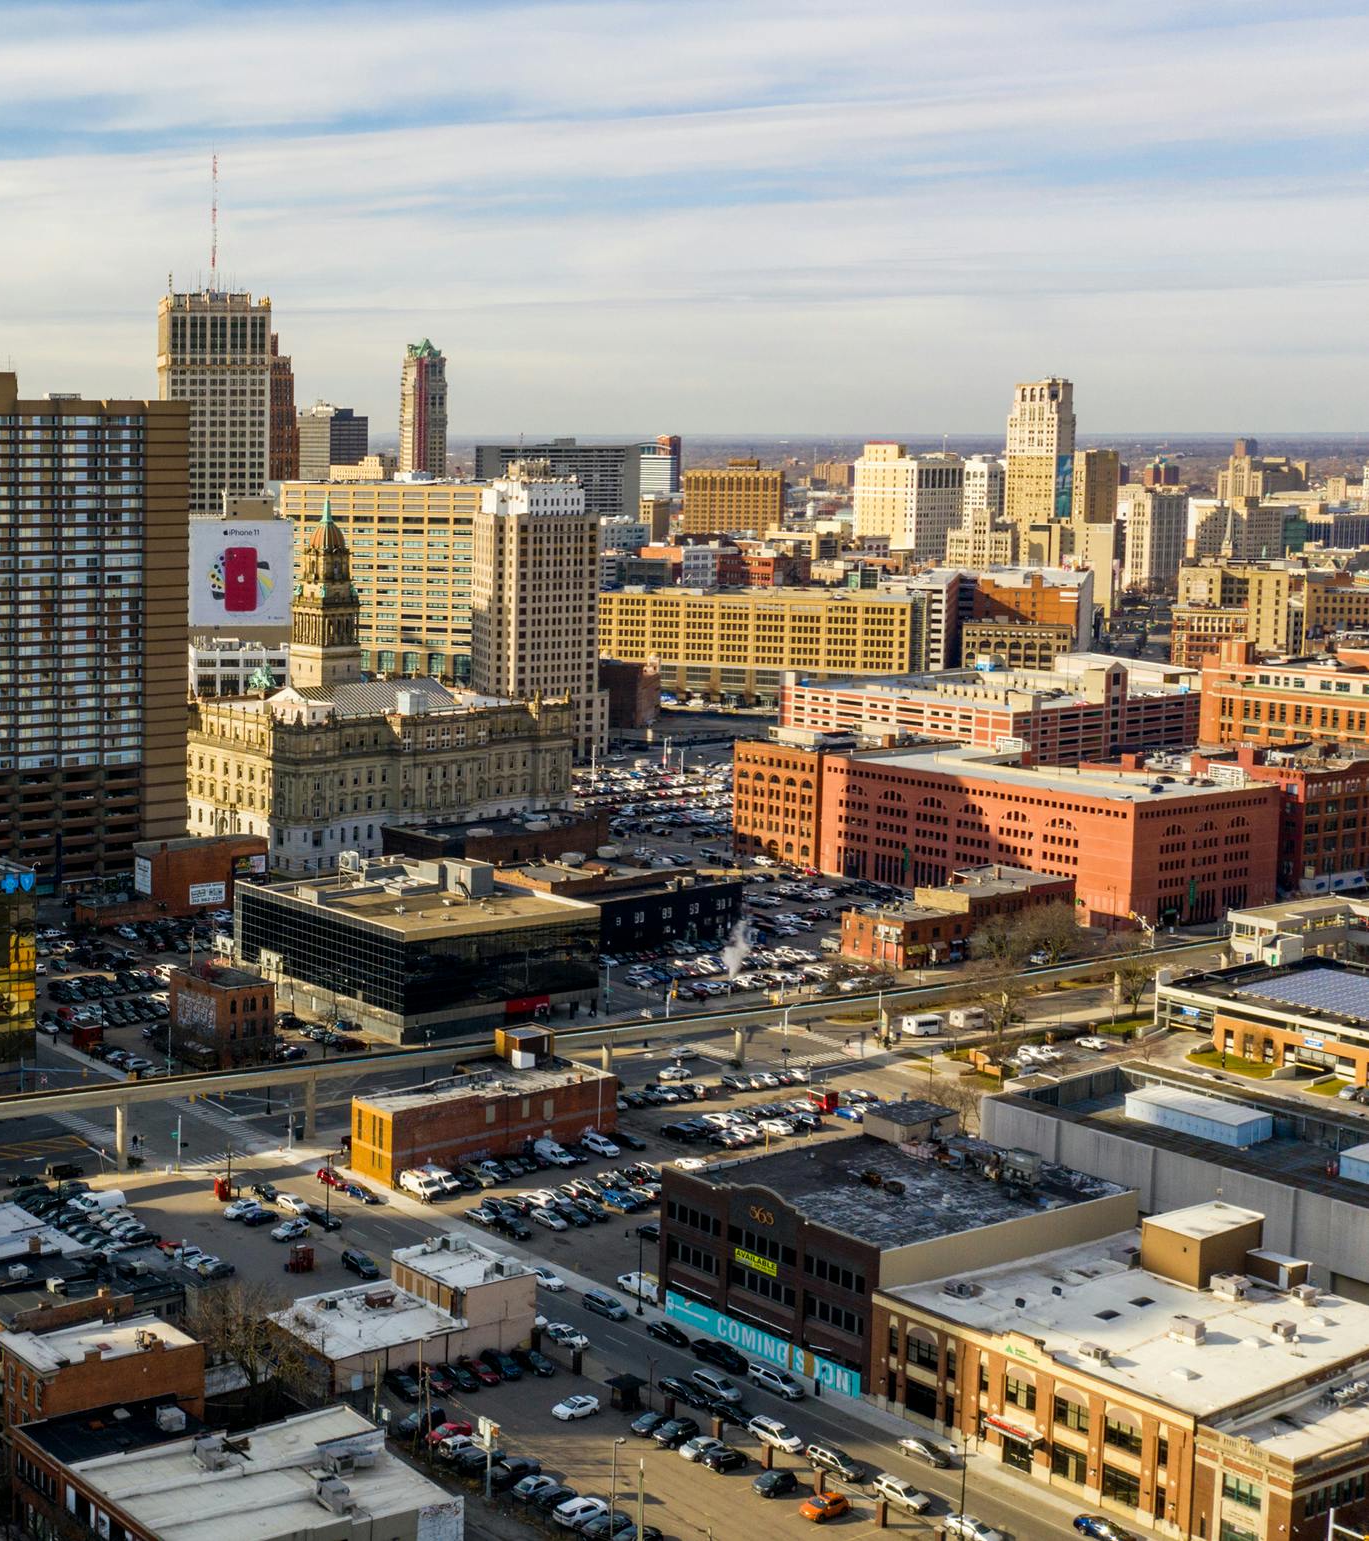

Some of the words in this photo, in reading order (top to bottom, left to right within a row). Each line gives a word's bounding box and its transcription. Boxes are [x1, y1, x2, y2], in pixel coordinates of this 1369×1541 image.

[749, 1205, 775, 1226] 565
[736, 1249, 776, 1270] AVAILABLE
[716, 1316, 790, 1365] COMING
